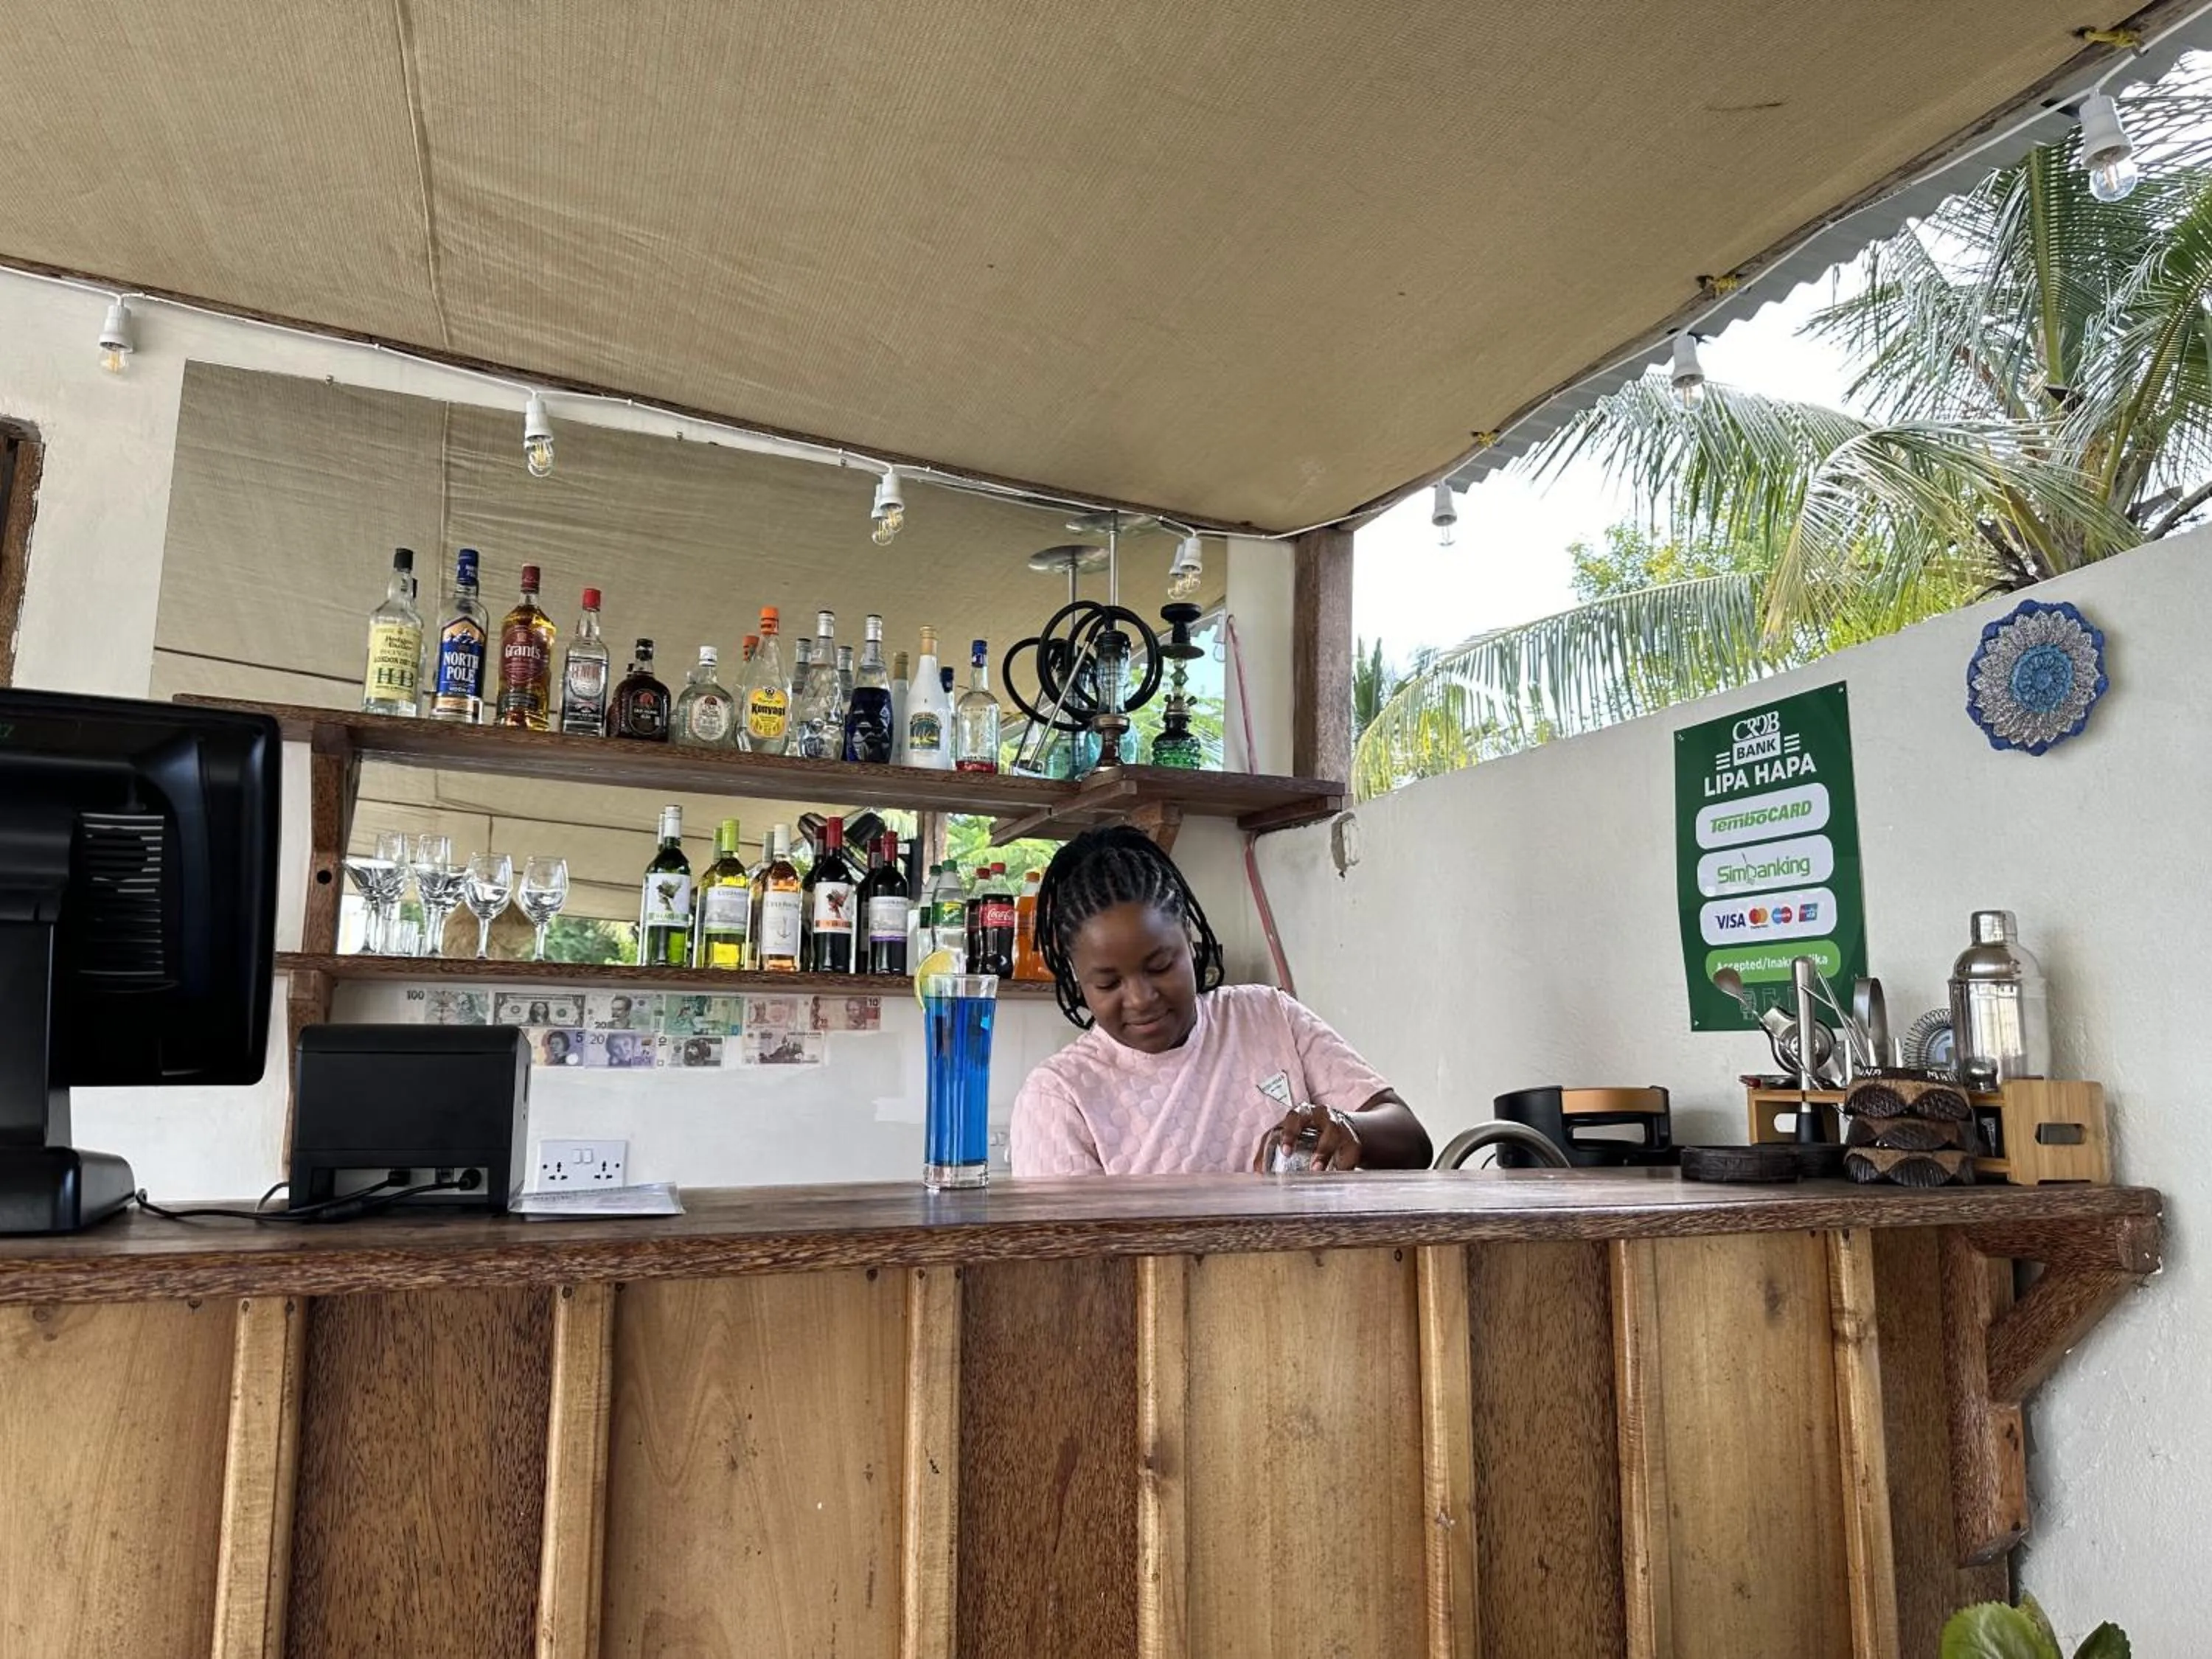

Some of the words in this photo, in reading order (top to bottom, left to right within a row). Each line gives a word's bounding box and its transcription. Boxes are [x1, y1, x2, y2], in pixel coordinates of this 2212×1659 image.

[443, 651, 479, 669] NORTH
[446, 666, 475, 683] POLE
[1732, 711, 1780, 742] CRDB
[1736, 738, 1776, 759] BANK
[1705, 769, 1750, 796] LIPA
[1755, 753, 1817, 785] HAPA
[1711, 800, 1812, 833] TemboCARD
[1715, 913, 1746, 929] VISA
[406, 990, 425, 1001] 100
[868, 998, 878, 1007] 10
[590, 1034, 605, 1044] 20
